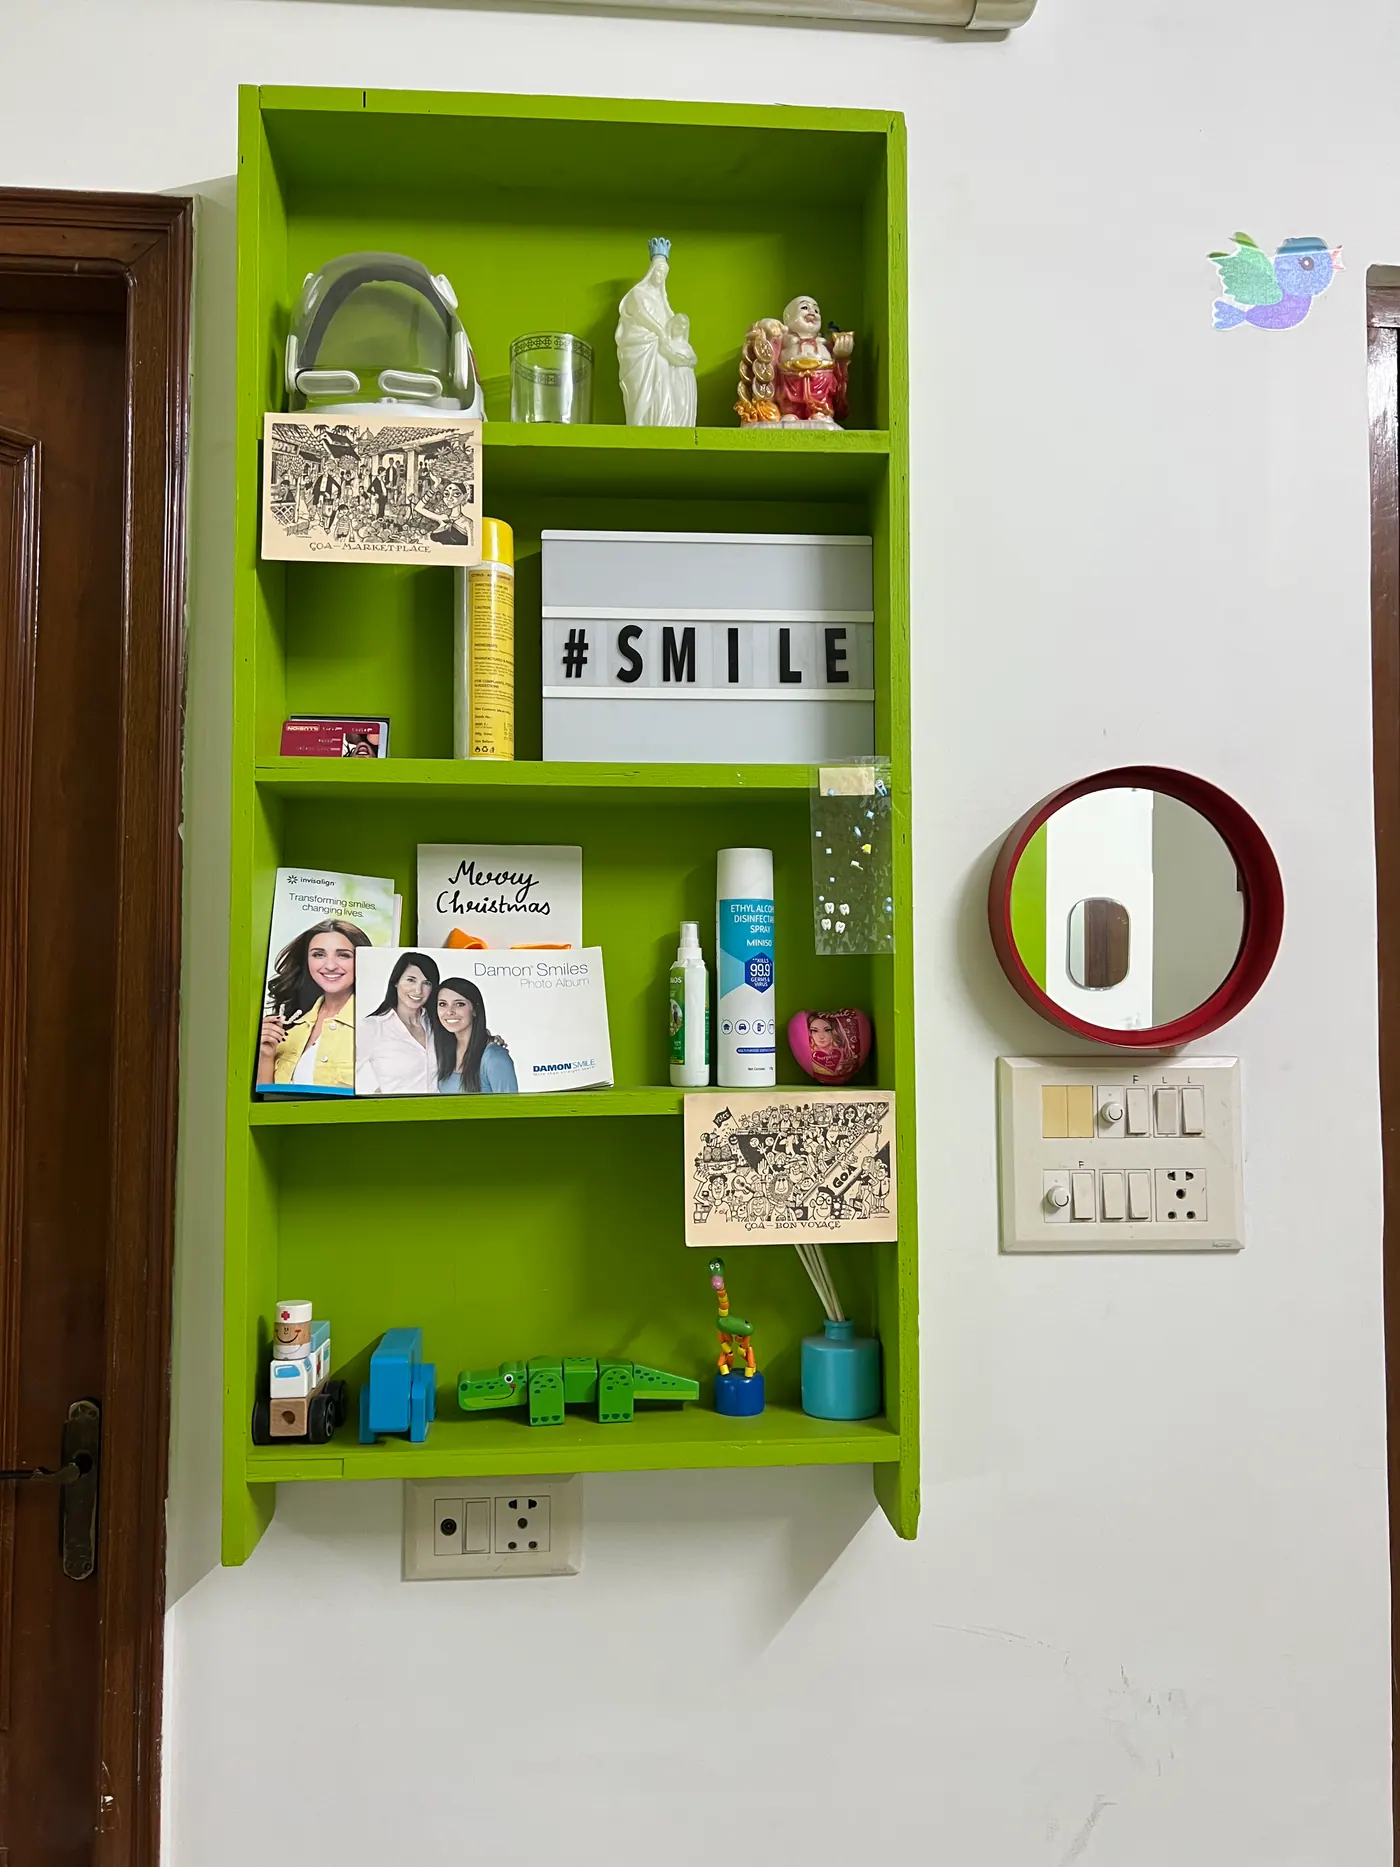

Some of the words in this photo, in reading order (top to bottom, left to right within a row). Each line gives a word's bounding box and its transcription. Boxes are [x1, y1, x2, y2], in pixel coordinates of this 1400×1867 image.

[300, 877, 335, 887] invisalign
[448, 860, 539, 903] Merry
[289, 892, 347, 908] Transforming
[436, 890, 550, 915] Christmas
[302, 903, 342, 917] changing
[344, 909, 364, 918] lives.
[730, 904, 755, 913] ETHYL
[750, 924, 771, 934] SPRAY
[746, 939, 773, 947] MINISO
[536, 962, 589, 977] Smiles
[520, 978, 553, 989] Photo
[555, 977, 590, 988] Album
[1132, 1075, 1139, 1084] F
[1162, 1076, 1167, 1084] L
[775, 1222, 798, 1230] BON
